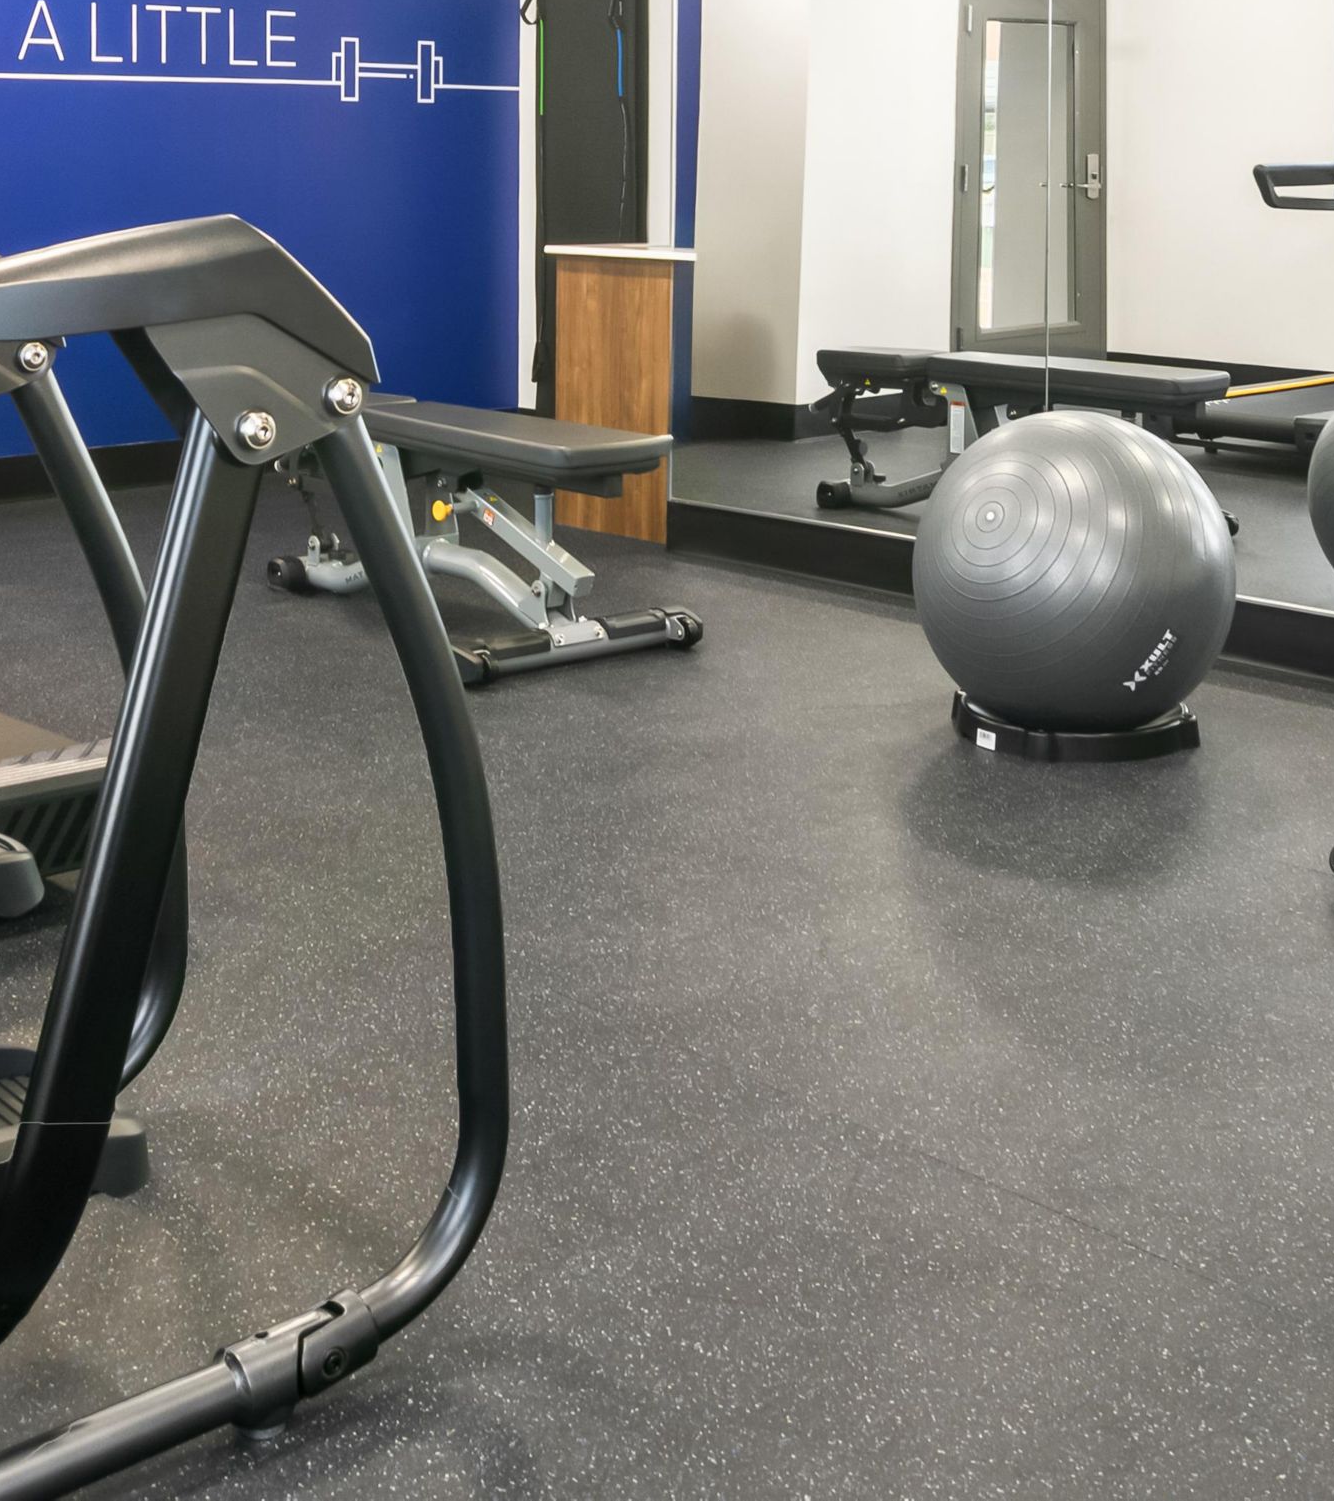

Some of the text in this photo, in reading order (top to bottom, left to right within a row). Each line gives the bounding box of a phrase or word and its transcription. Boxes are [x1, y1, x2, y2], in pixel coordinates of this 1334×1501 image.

[18, 0, 65, 62] A
[90, 2, 297, 68] LITTLE
[1139, 628, 1173, 673] XULT
